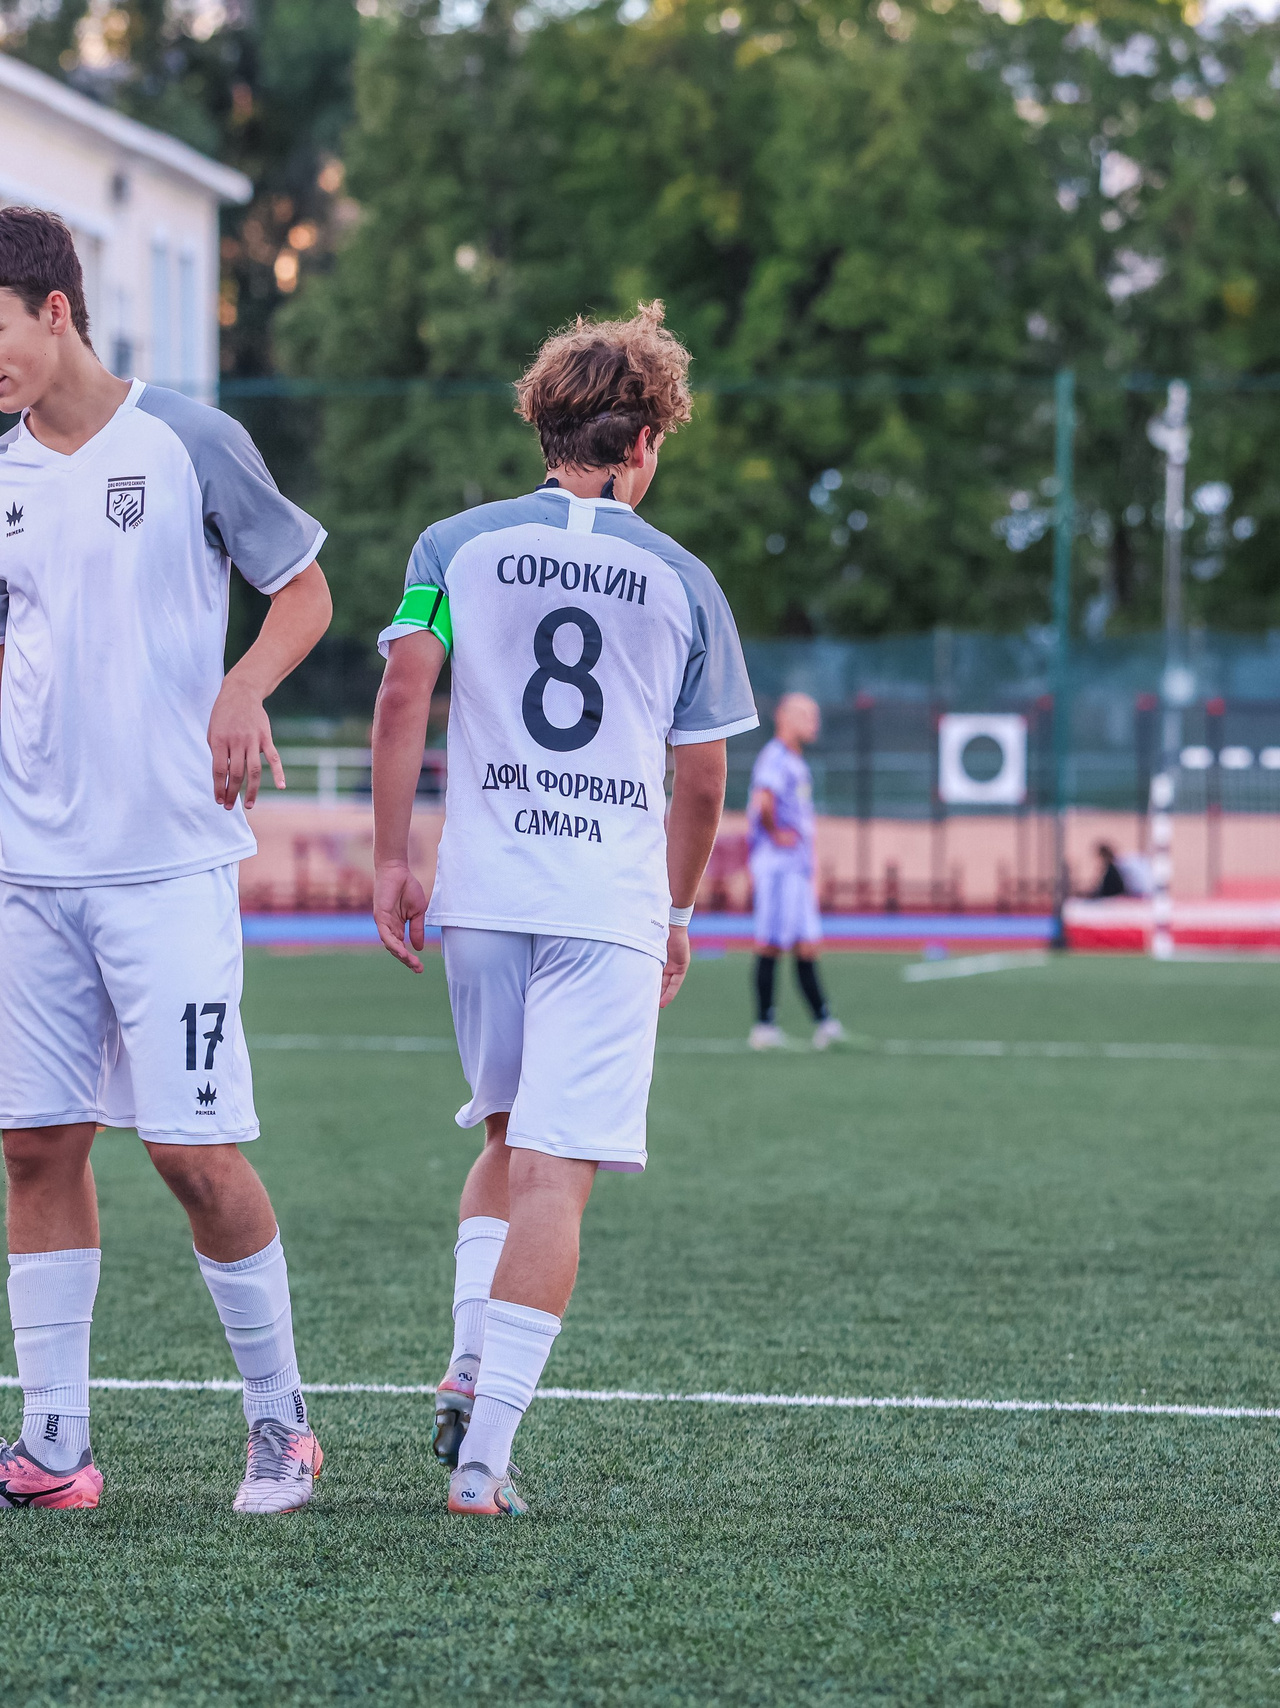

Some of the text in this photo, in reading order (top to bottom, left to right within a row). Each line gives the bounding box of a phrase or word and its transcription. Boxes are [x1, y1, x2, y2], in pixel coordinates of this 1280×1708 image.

[132, 518, 144, 529] 2015
[496, 554, 648, 606] СОРОКИН
[521, 606, 604, 752] 8
[481, 762, 649, 811] ДФЦ ФОРВАРД
[514, 808, 602, 843] САМАРА
[179, 1002, 227, 1071] 17
